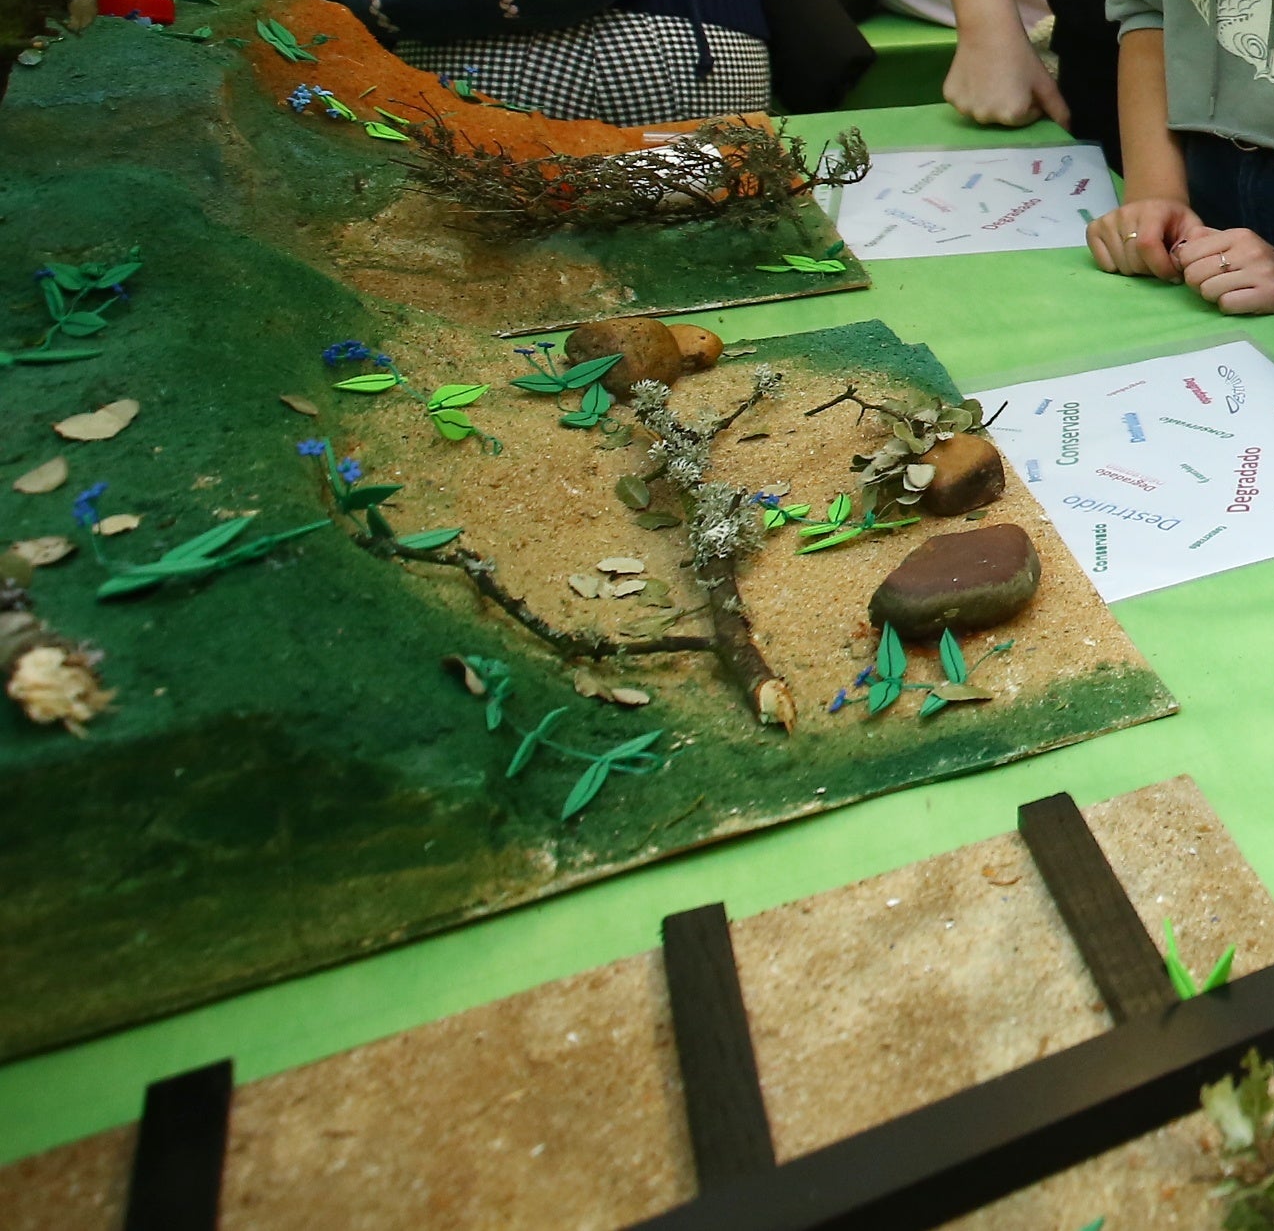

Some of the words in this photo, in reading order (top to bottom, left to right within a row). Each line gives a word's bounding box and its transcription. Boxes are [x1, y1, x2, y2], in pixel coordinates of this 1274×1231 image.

[1056, 401, 1081, 467] Conservado
[1159, 416, 1235, 440] Conservado
[1095, 468, 1156, 493] Degradado
[1228, 446, 1262, 514] Degradado
[1093, 523, 1108, 574] Conservado
